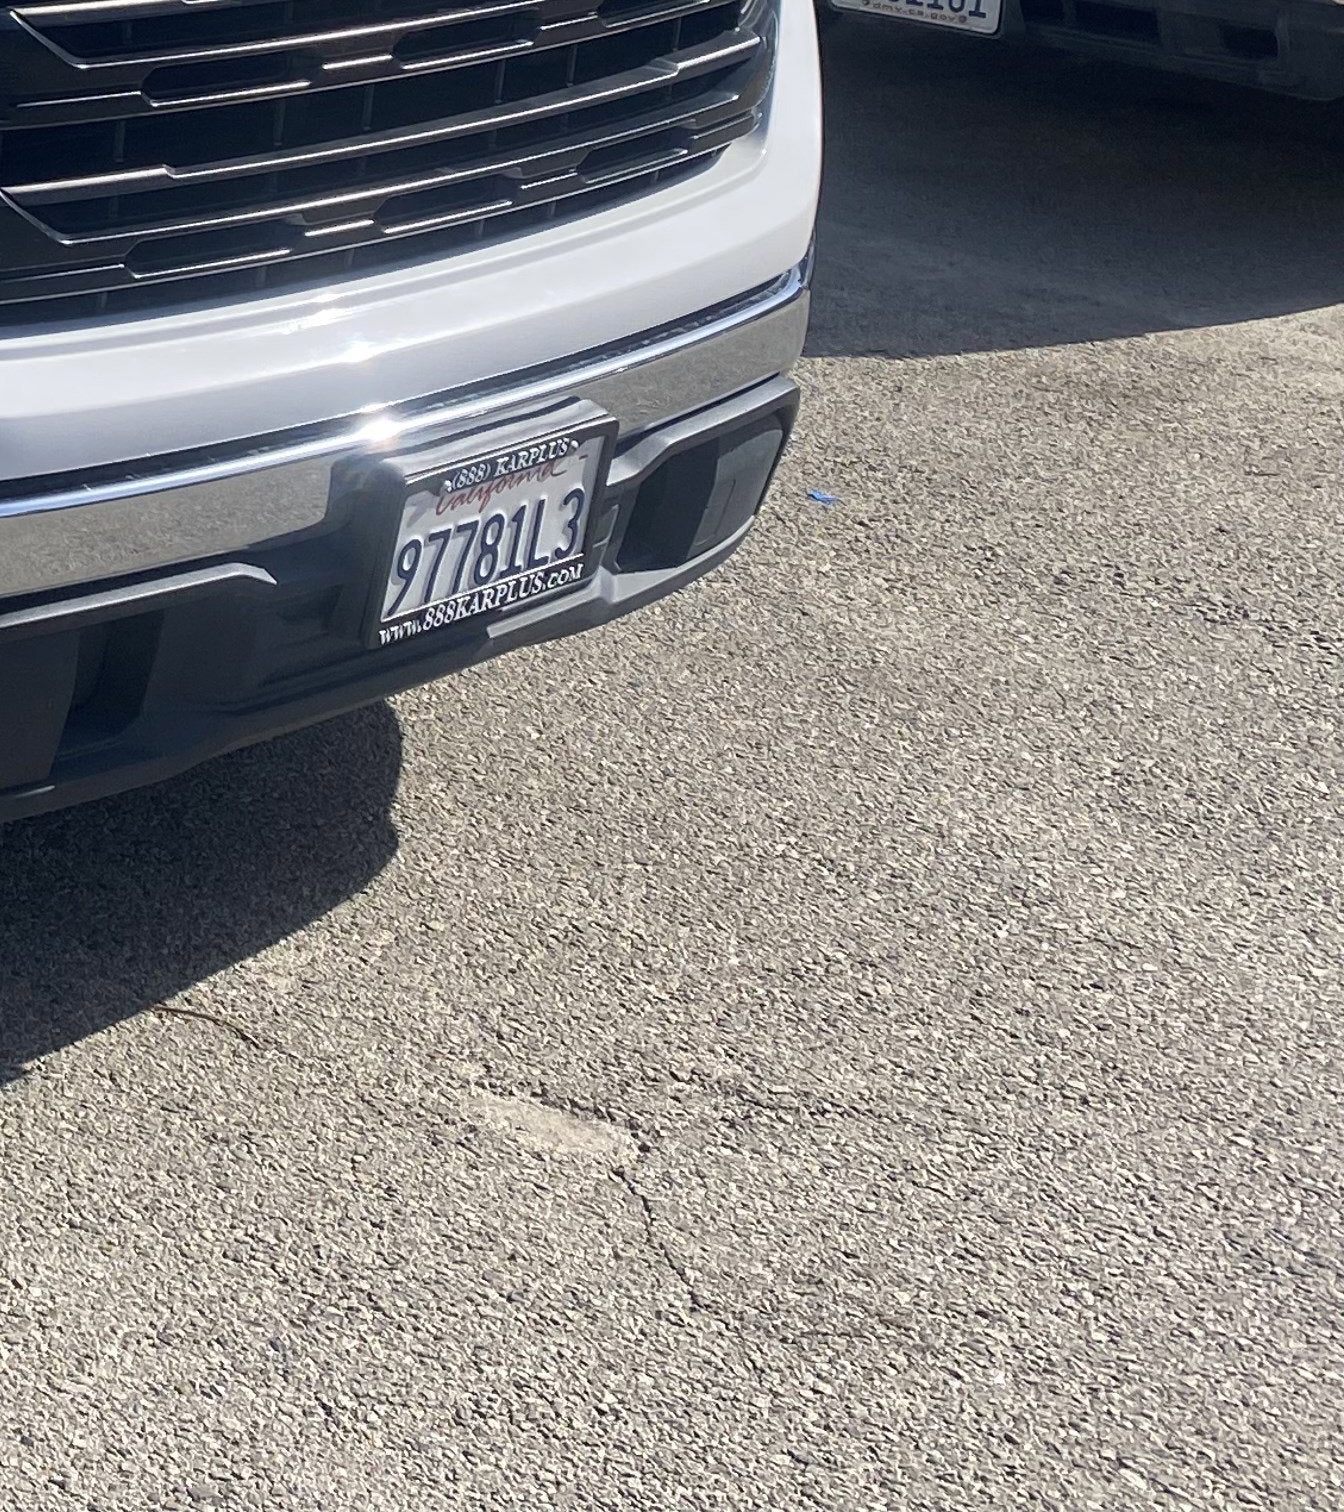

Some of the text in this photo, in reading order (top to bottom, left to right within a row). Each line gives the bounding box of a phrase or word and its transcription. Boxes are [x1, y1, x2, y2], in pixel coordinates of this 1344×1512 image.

[451, 437, 571, 490] (888) KARPLUS
[386, 487, 586, 619] 97781L3
